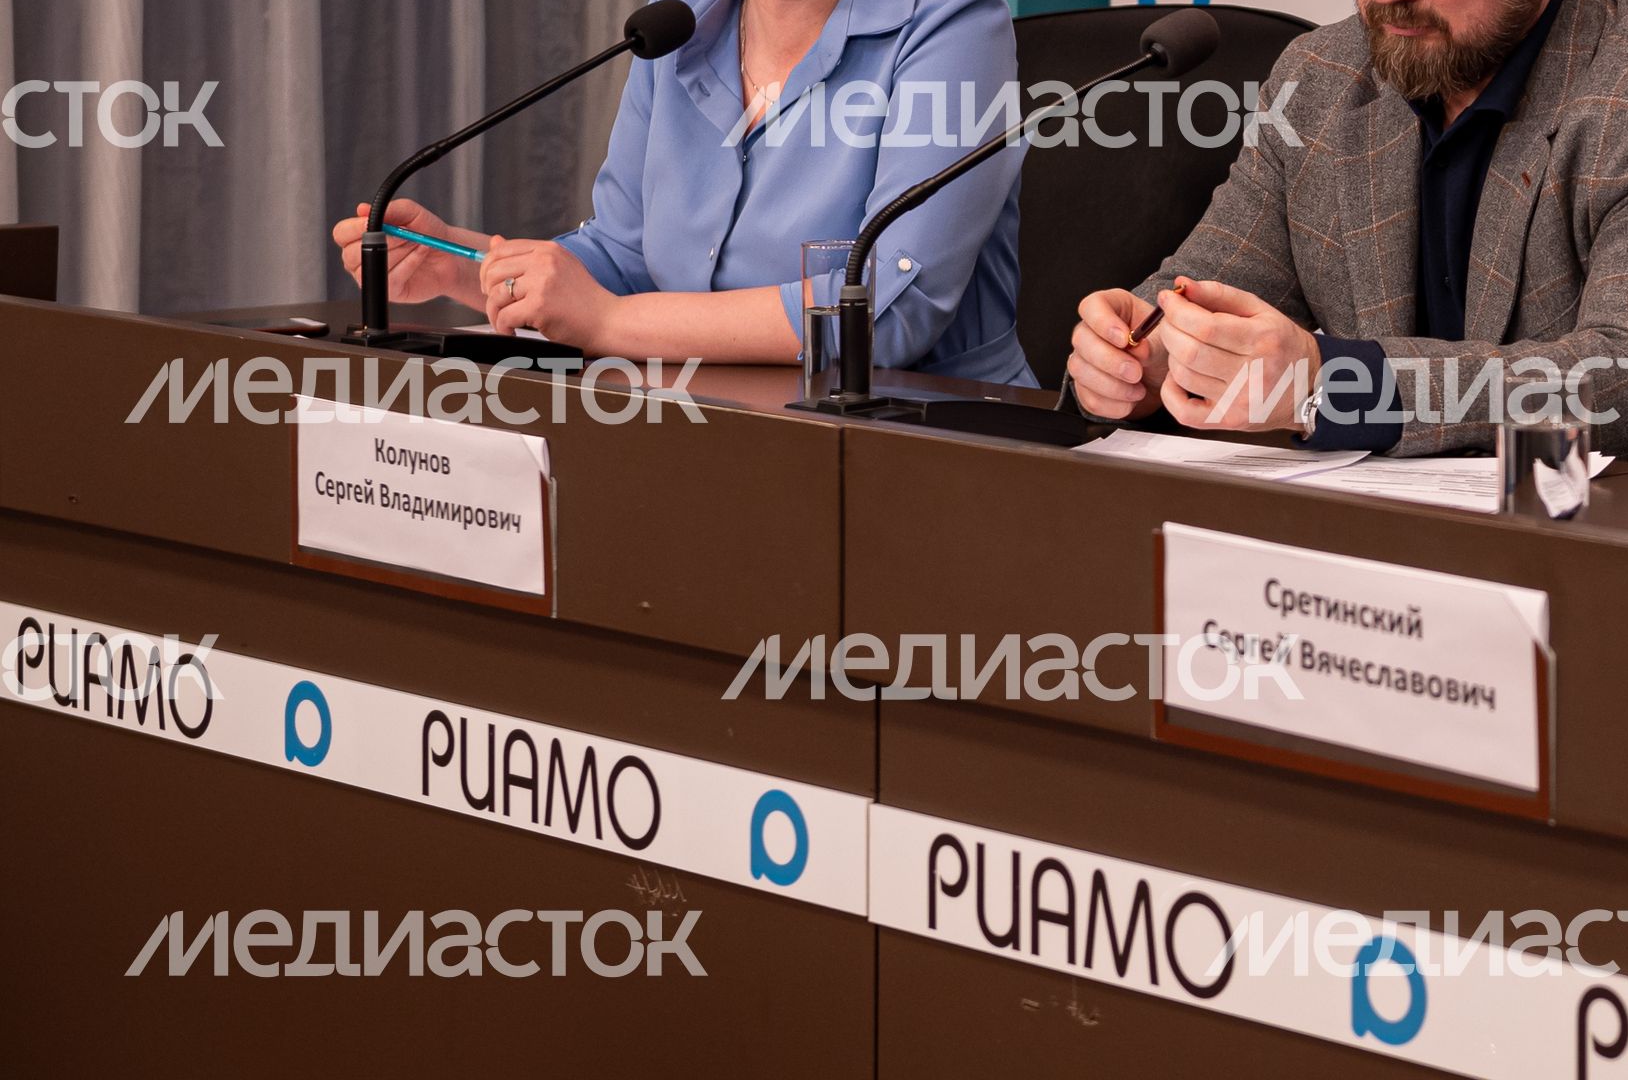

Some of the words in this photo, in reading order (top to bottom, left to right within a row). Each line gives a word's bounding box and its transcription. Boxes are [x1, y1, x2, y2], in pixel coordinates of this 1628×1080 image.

[374, 437, 451, 475] Колунов
[315, 471, 375, 505] Сергей
[379, 483, 522, 533] Владимирович
[1264, 578, 1424, 641] Сретинский
[1202, 618, 1293, 668] Сергей
[1300, 638, 1497, 712] Вячеславович
